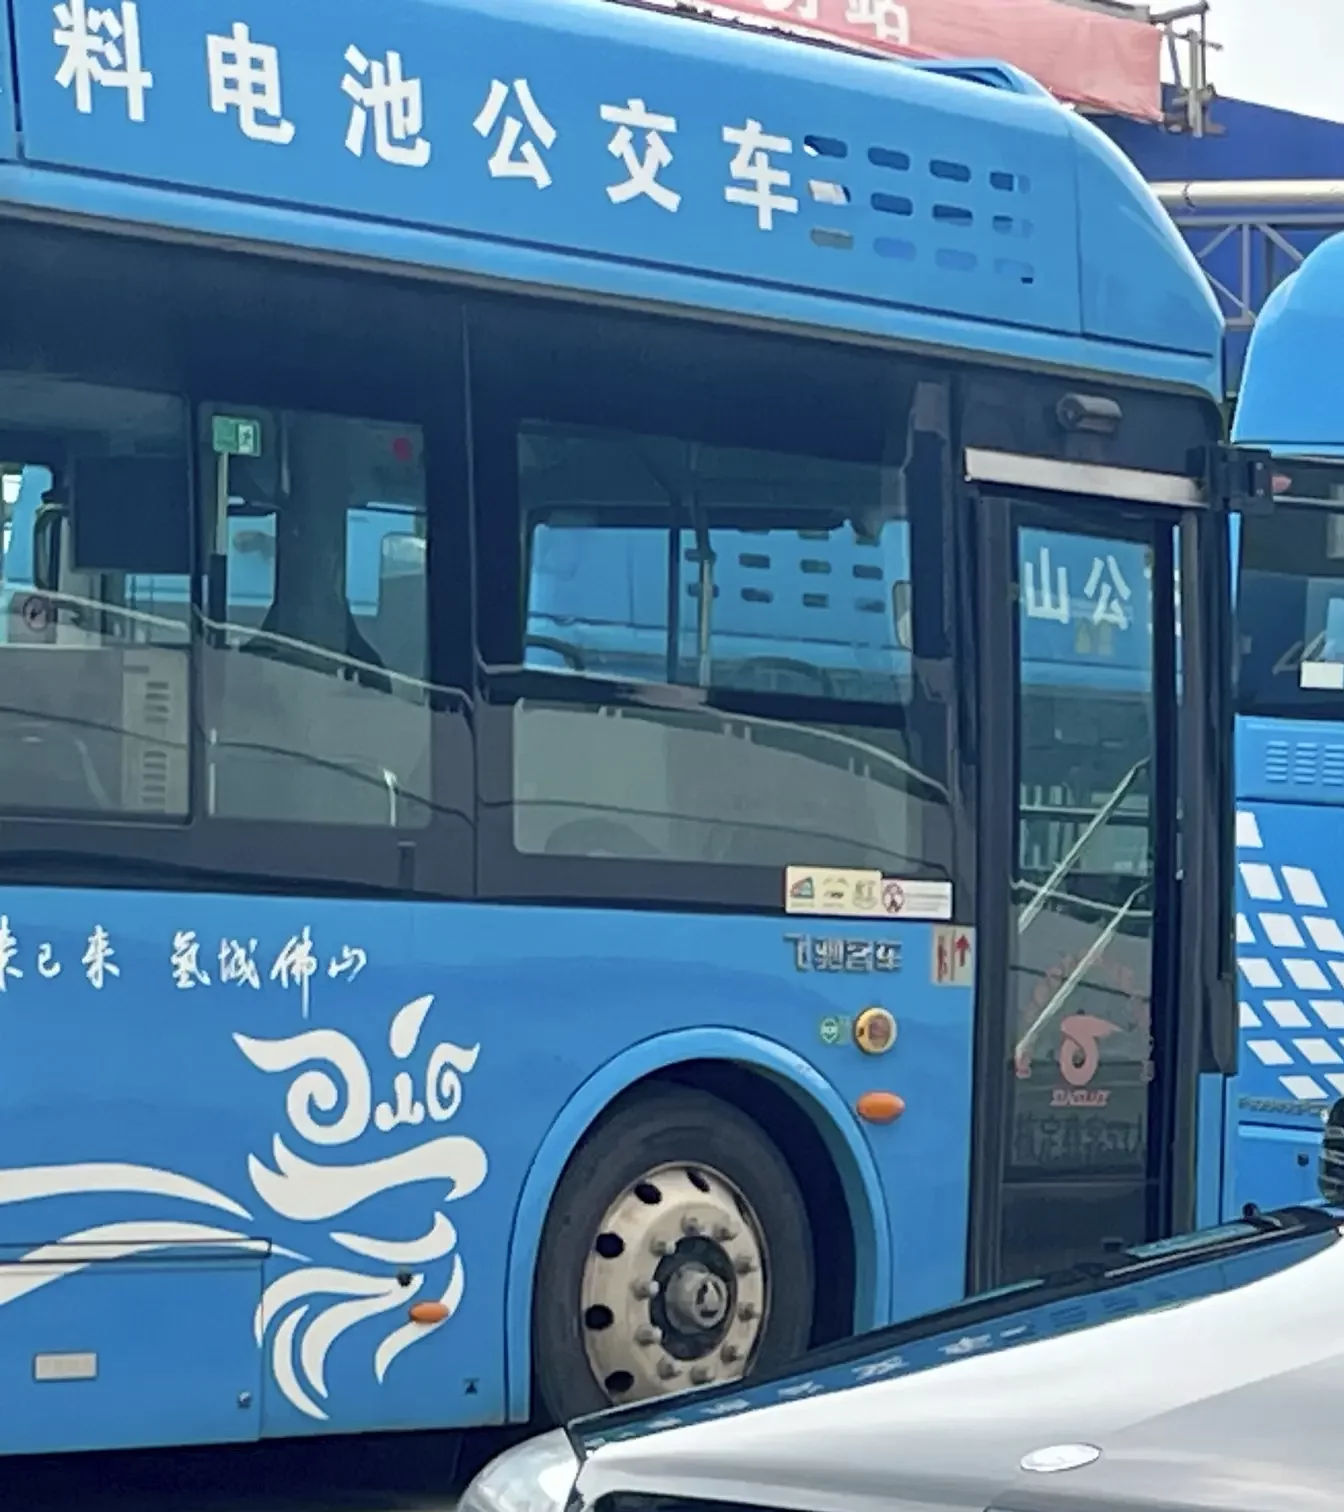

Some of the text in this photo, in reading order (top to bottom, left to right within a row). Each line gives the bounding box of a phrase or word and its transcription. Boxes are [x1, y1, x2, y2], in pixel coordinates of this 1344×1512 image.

[53, 2, 799, 231] 料电池公交车
